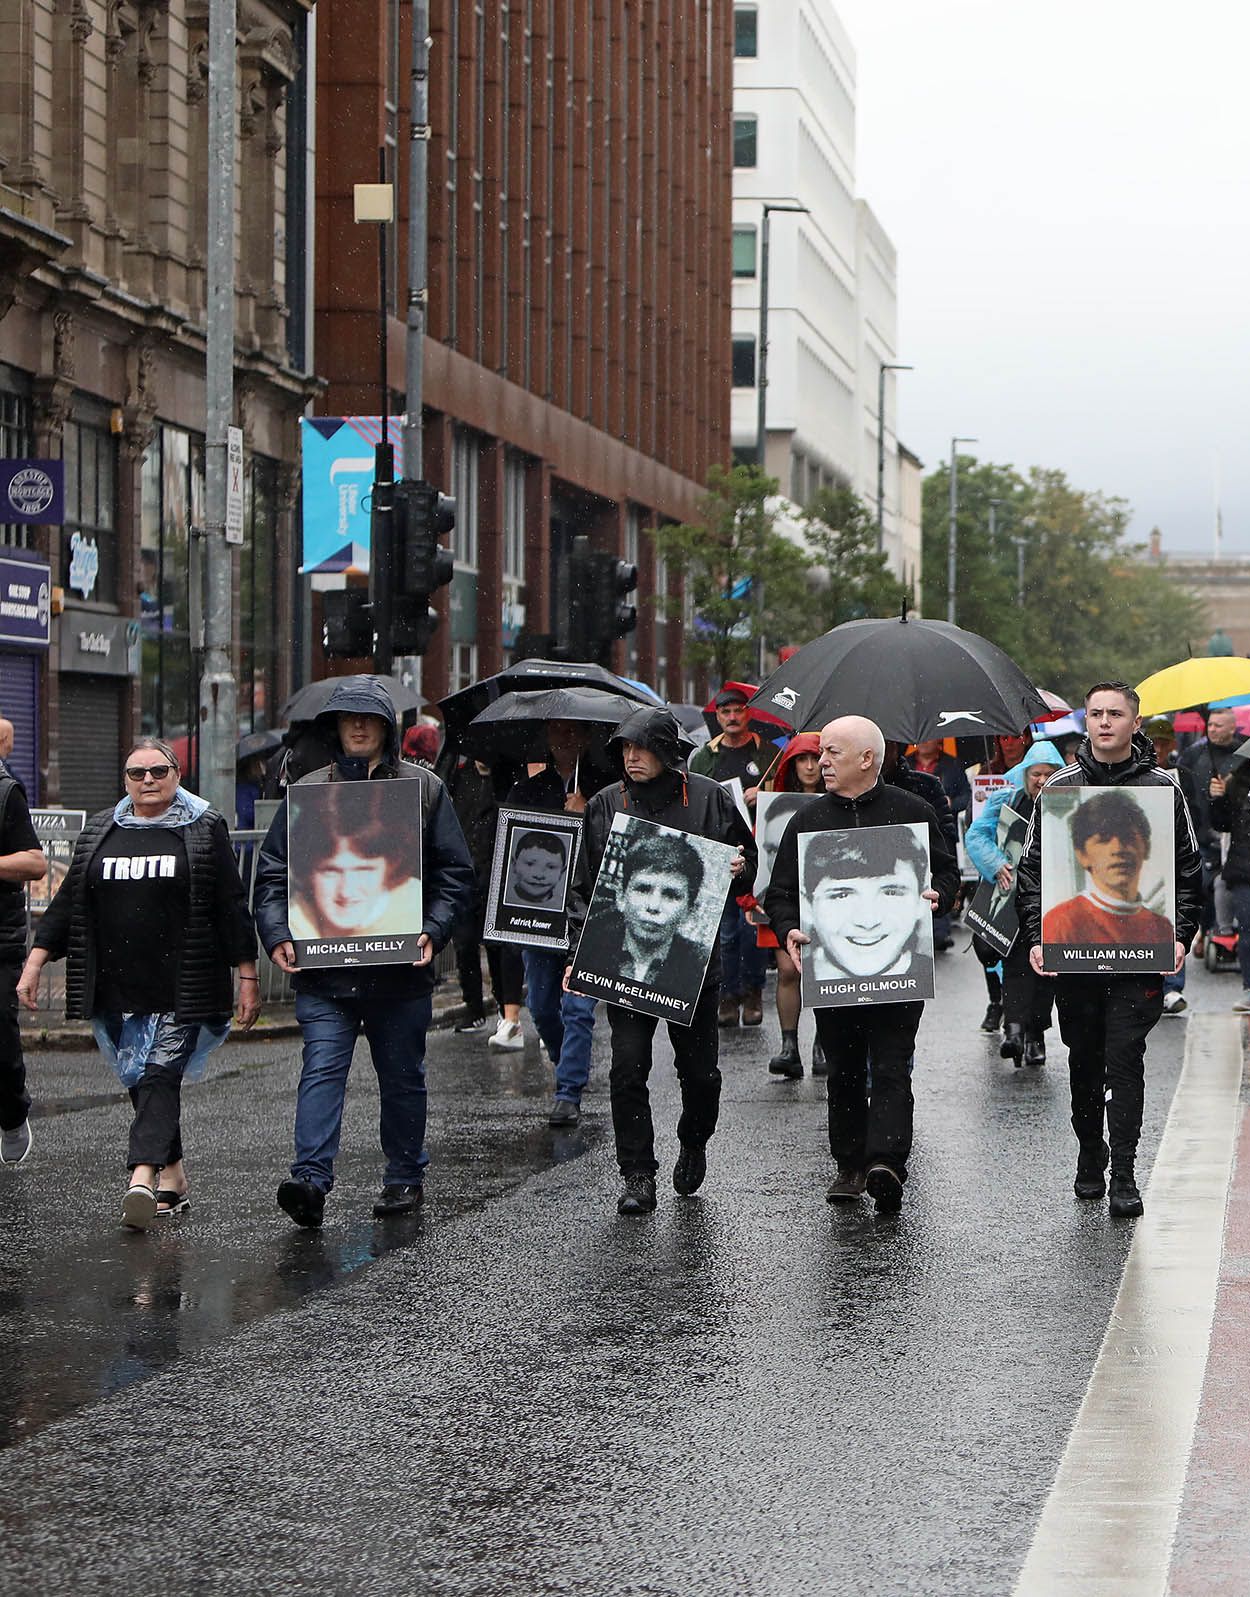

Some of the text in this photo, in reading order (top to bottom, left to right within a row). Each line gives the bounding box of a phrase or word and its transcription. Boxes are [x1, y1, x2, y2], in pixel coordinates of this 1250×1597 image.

[102, 855, 176, 880] TRUTH
[510, 917, 552, 929] Patrick Rooney
[968, 910, 987, 928] GERALD
[306, 940, 405, 955] MICHAEL KELLY
[1063, 949, 1154, 959] WILLIAM NASH
[577, 970, 690, 1011] KEVIN McELHINNEY
[820, 979, 917, 995] HUGH GILMOUR
